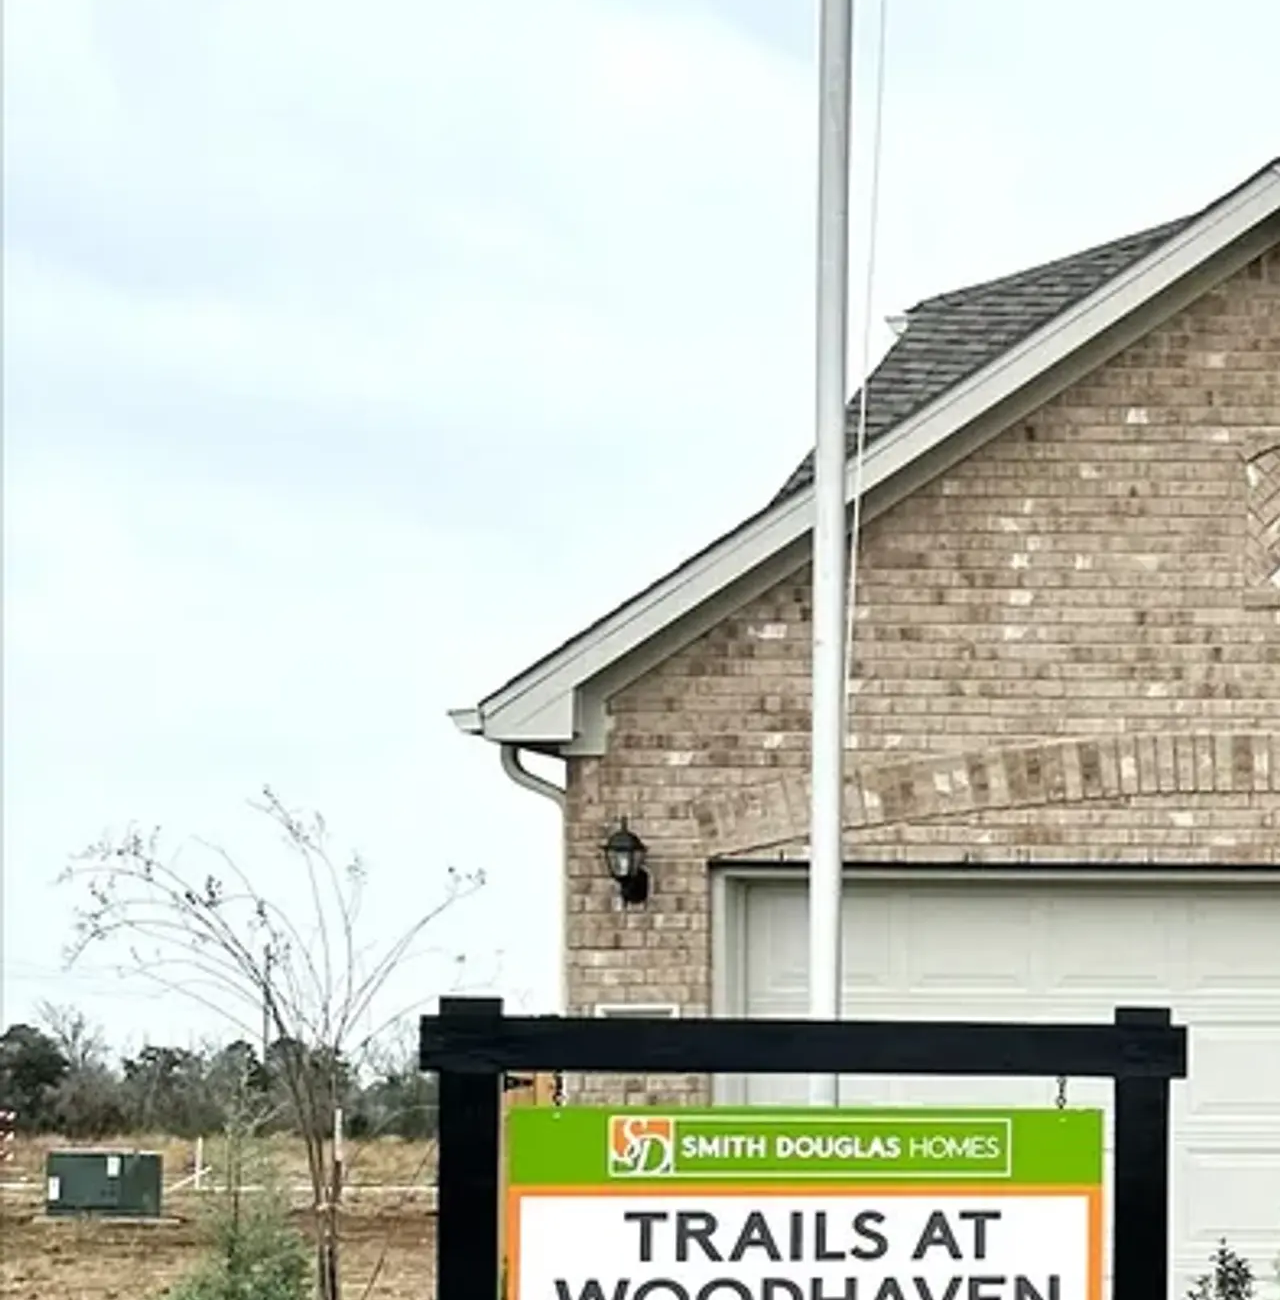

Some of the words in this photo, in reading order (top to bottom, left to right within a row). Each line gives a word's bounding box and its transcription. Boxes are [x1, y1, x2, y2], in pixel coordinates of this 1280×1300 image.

[680, 1135, 767, 1159] SMITH
[775, 1135, 901, 1159] DOUGLAS
[909, 1135, 1000, 1159] HOMES
[623, 1210, 888, 1263] TRAILS
[911, 1210, 1002, 1261] AT
